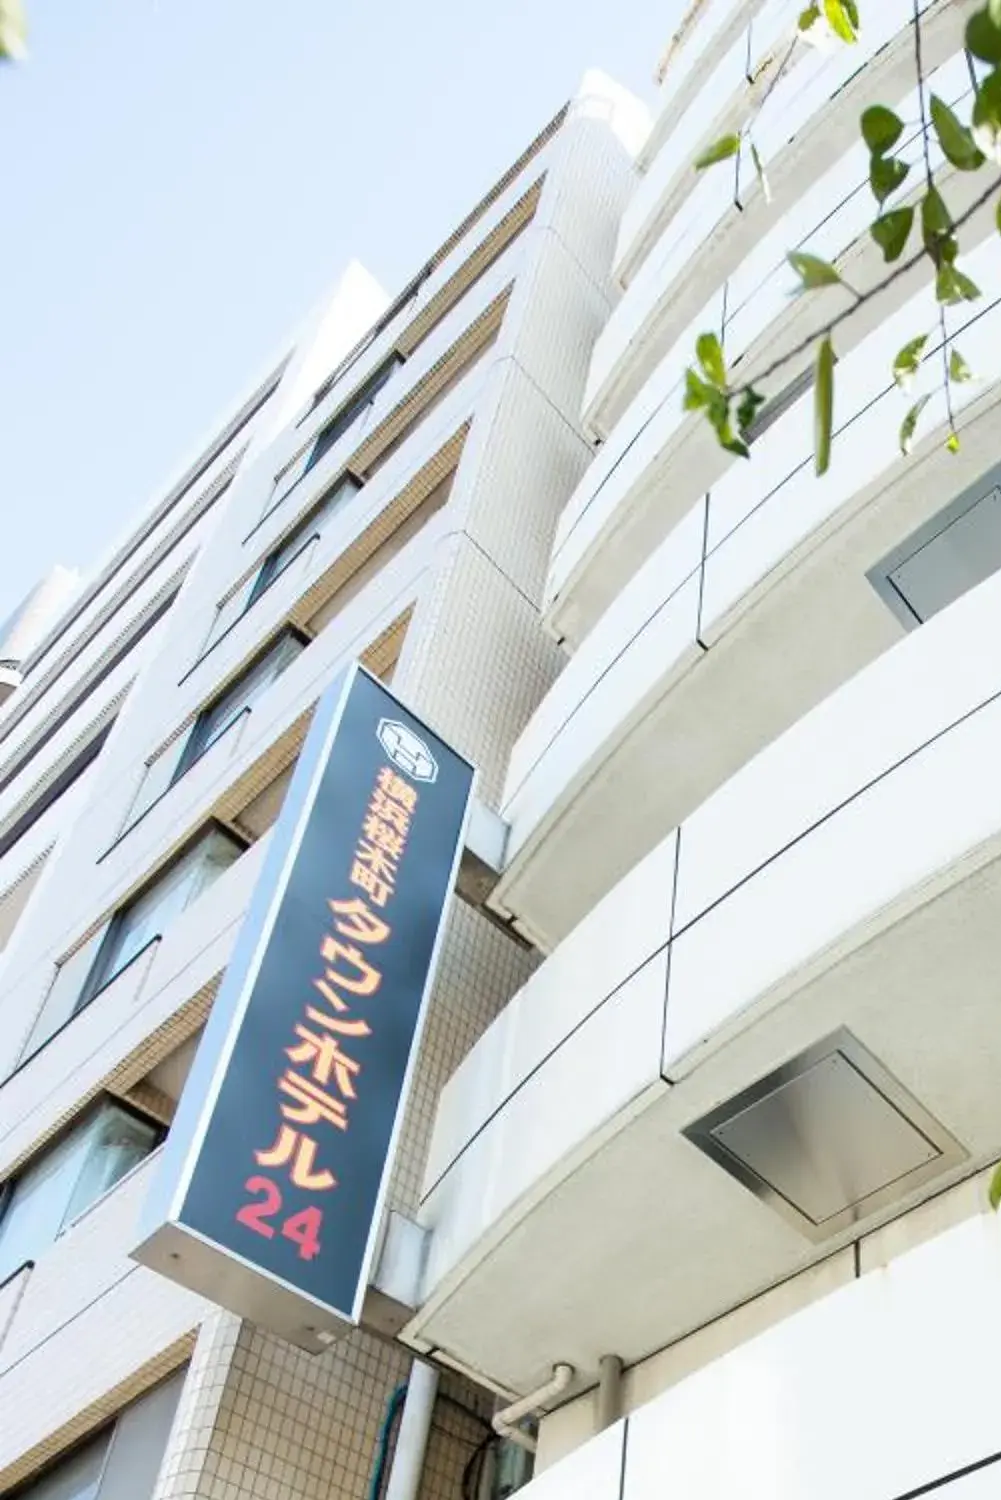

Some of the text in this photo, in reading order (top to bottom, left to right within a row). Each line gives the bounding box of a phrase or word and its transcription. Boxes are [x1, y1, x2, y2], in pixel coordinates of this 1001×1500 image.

[235, 767, 418, 1261] 横浜桜木町 タウンホテル 24
